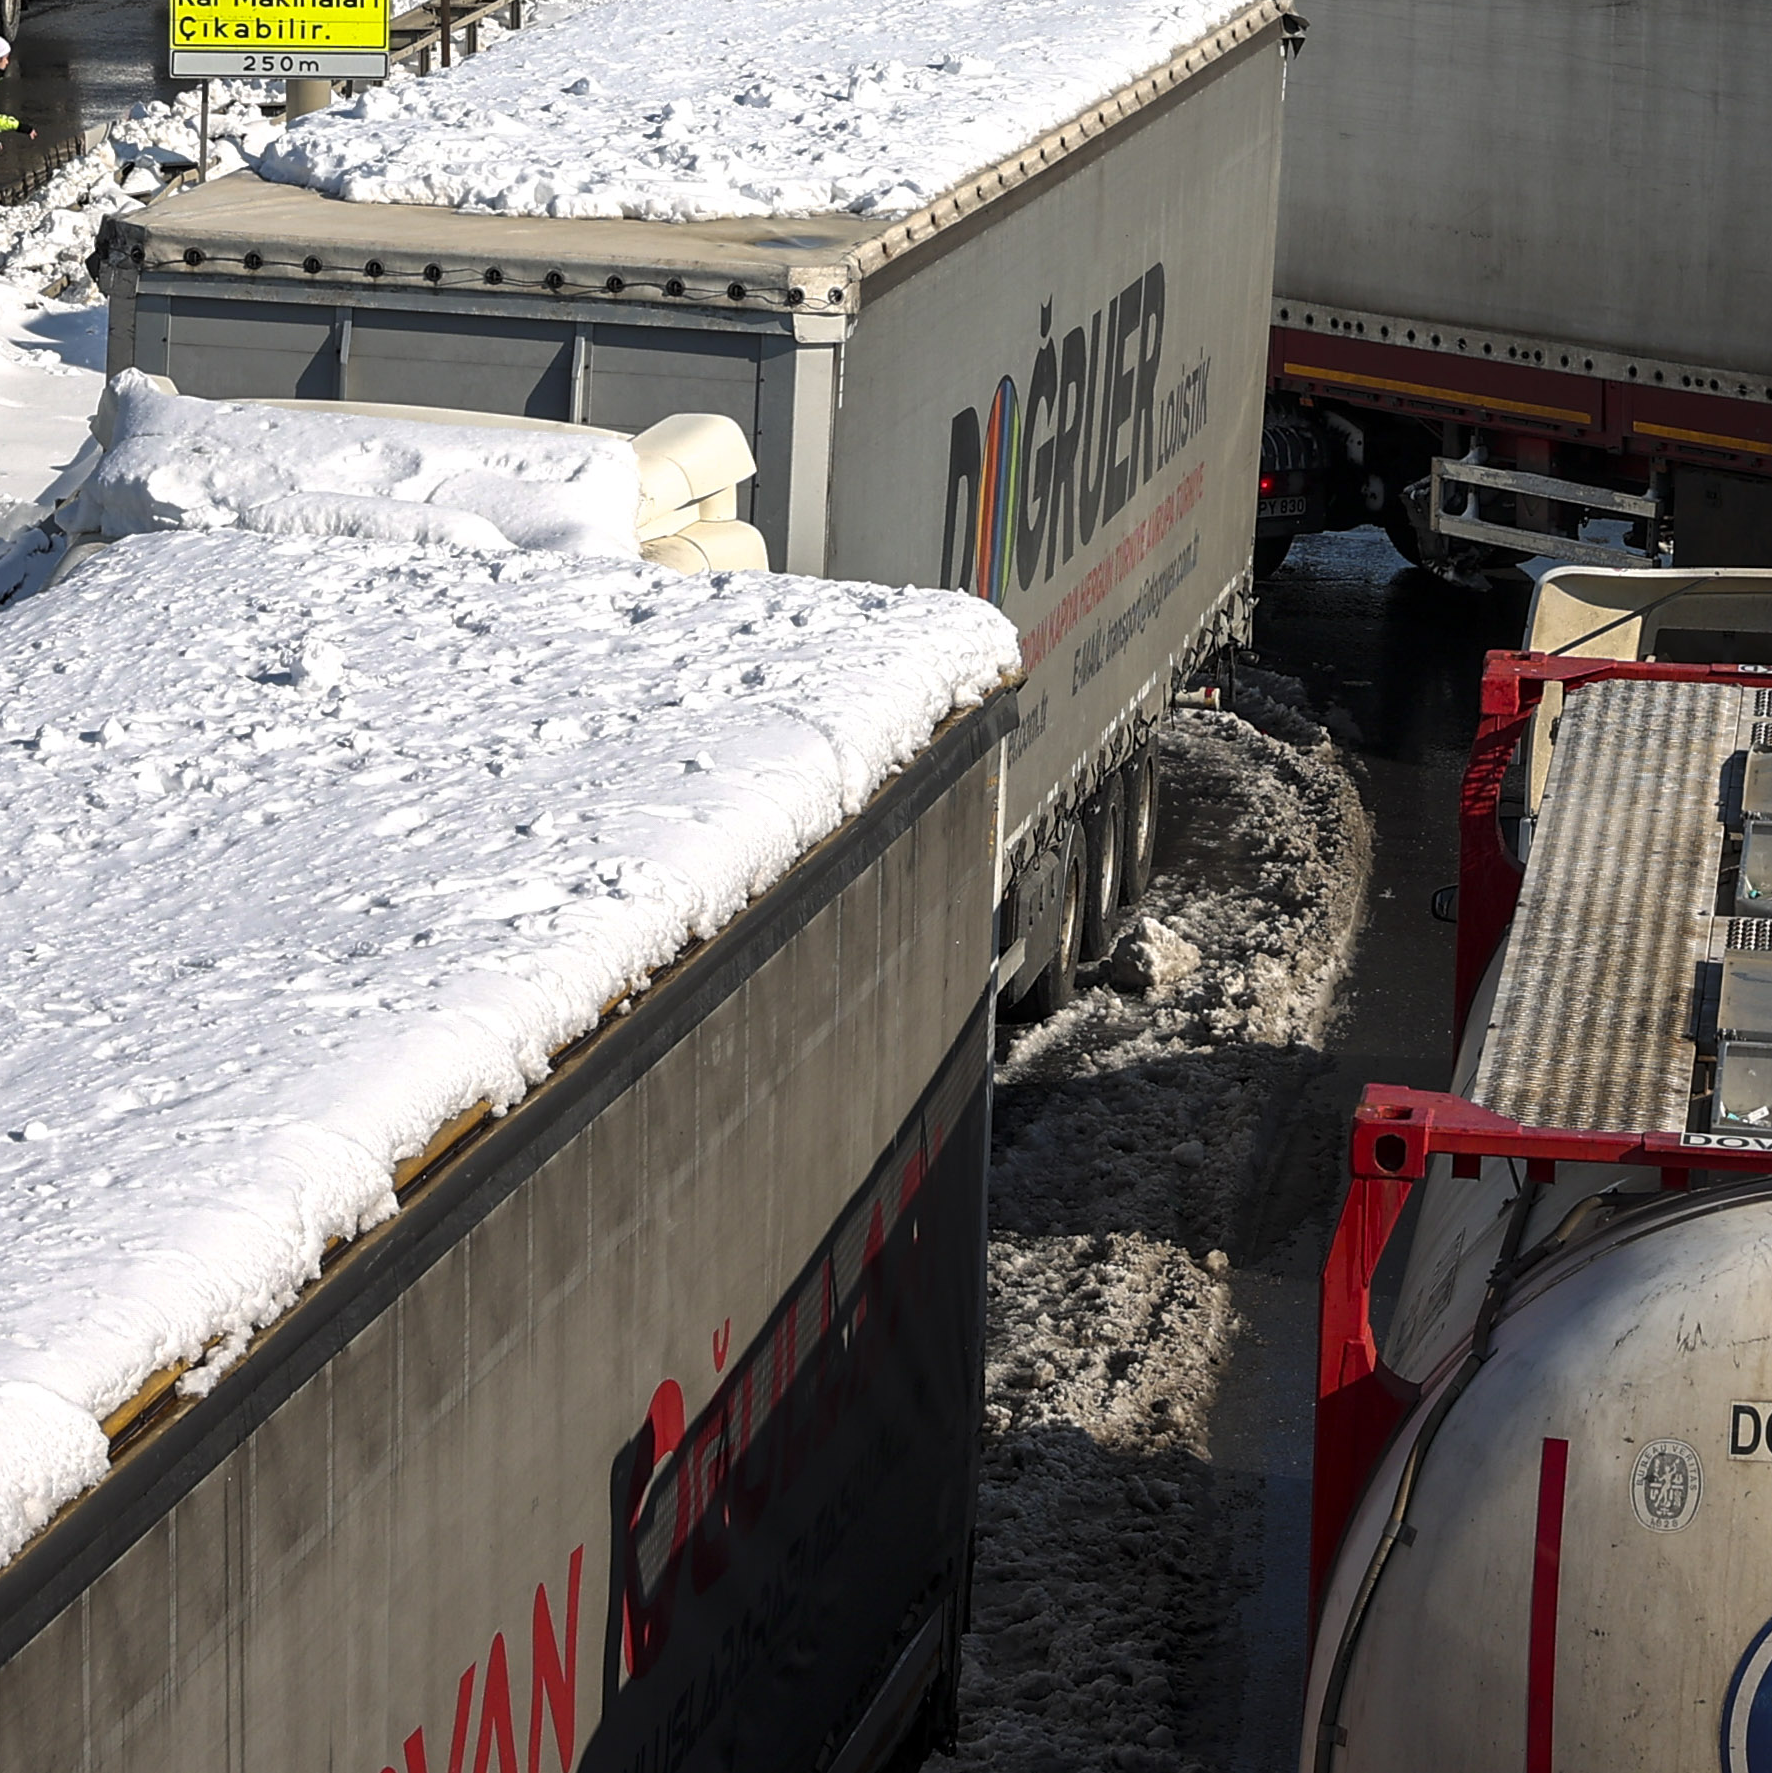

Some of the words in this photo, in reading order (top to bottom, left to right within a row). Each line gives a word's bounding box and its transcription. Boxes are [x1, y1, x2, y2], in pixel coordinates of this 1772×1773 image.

[1280, 497, 1305, 514] 830
[1635, 1444, 1667, 1487] BUREAU
[1672, 1445, 1699, 1492] VERITAS
